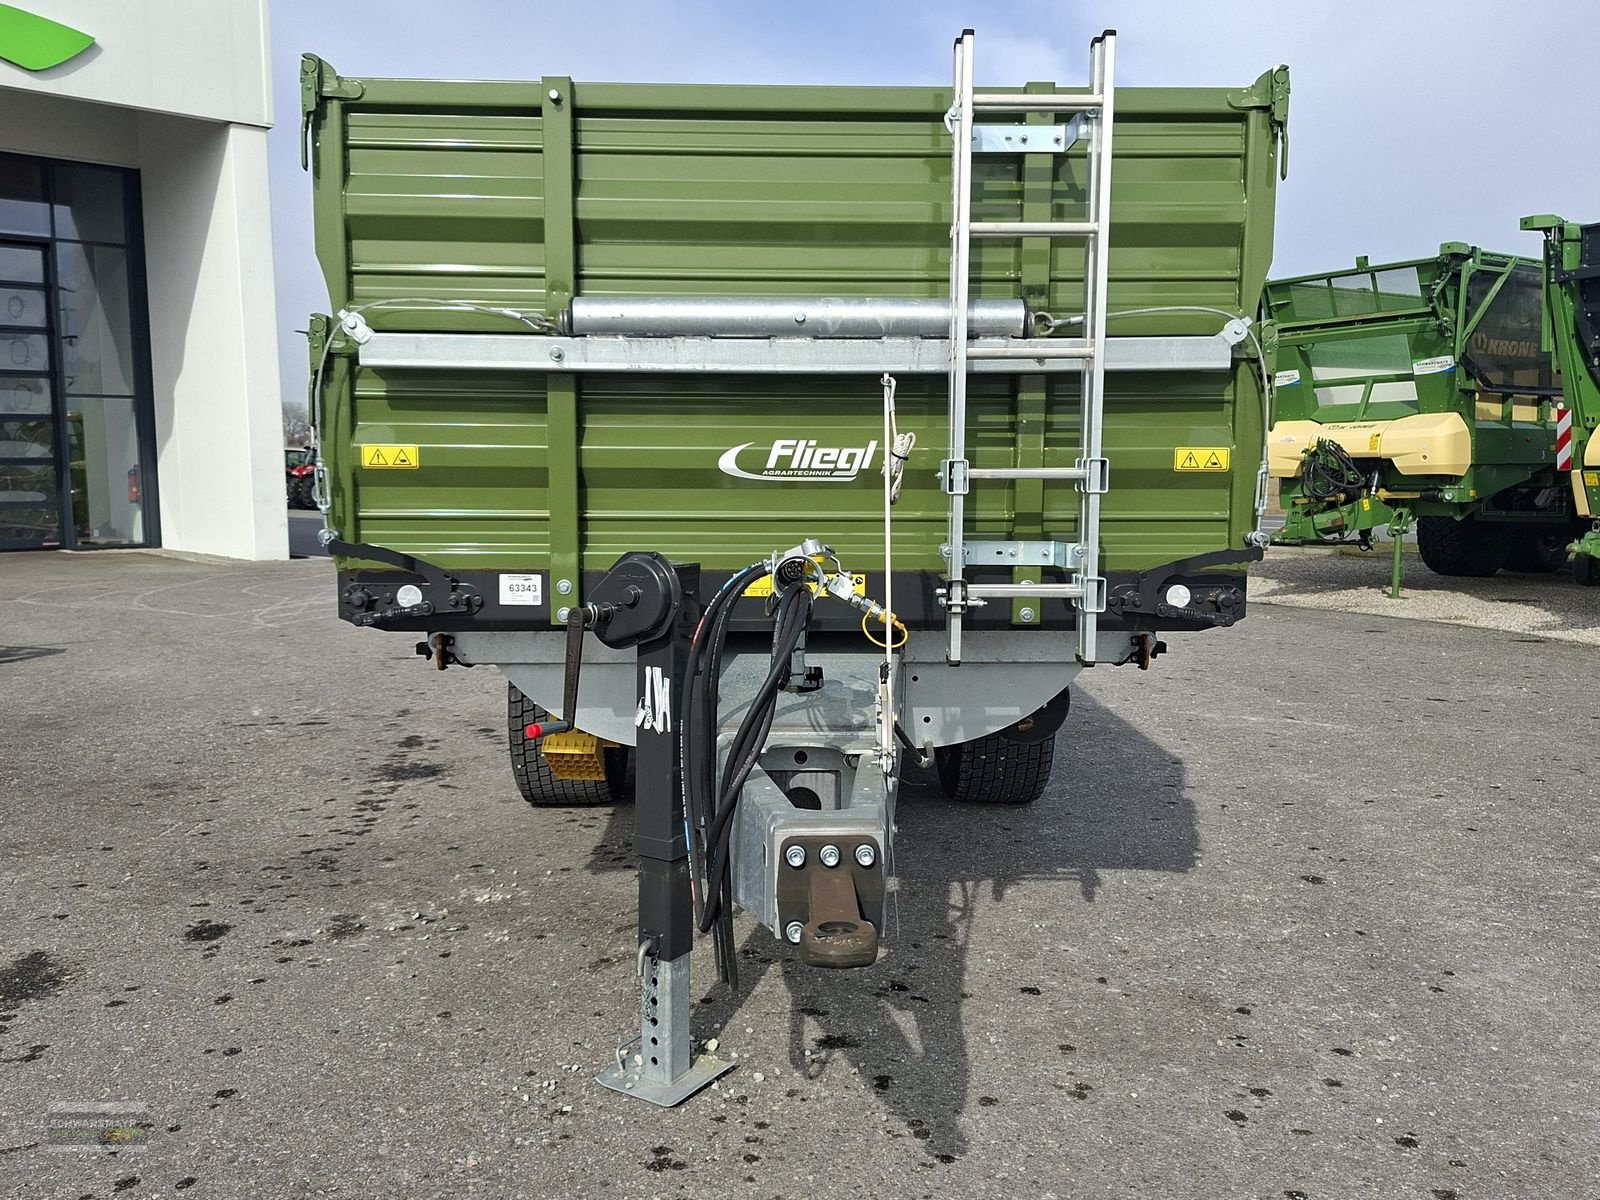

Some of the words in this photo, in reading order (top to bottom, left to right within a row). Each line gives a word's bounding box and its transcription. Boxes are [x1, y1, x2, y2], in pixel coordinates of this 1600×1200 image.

[1488, 339, 1538, 358] KRONE
[765, 440, 878, 476] Fliegl
[509, 583, 538, 593] 63343
